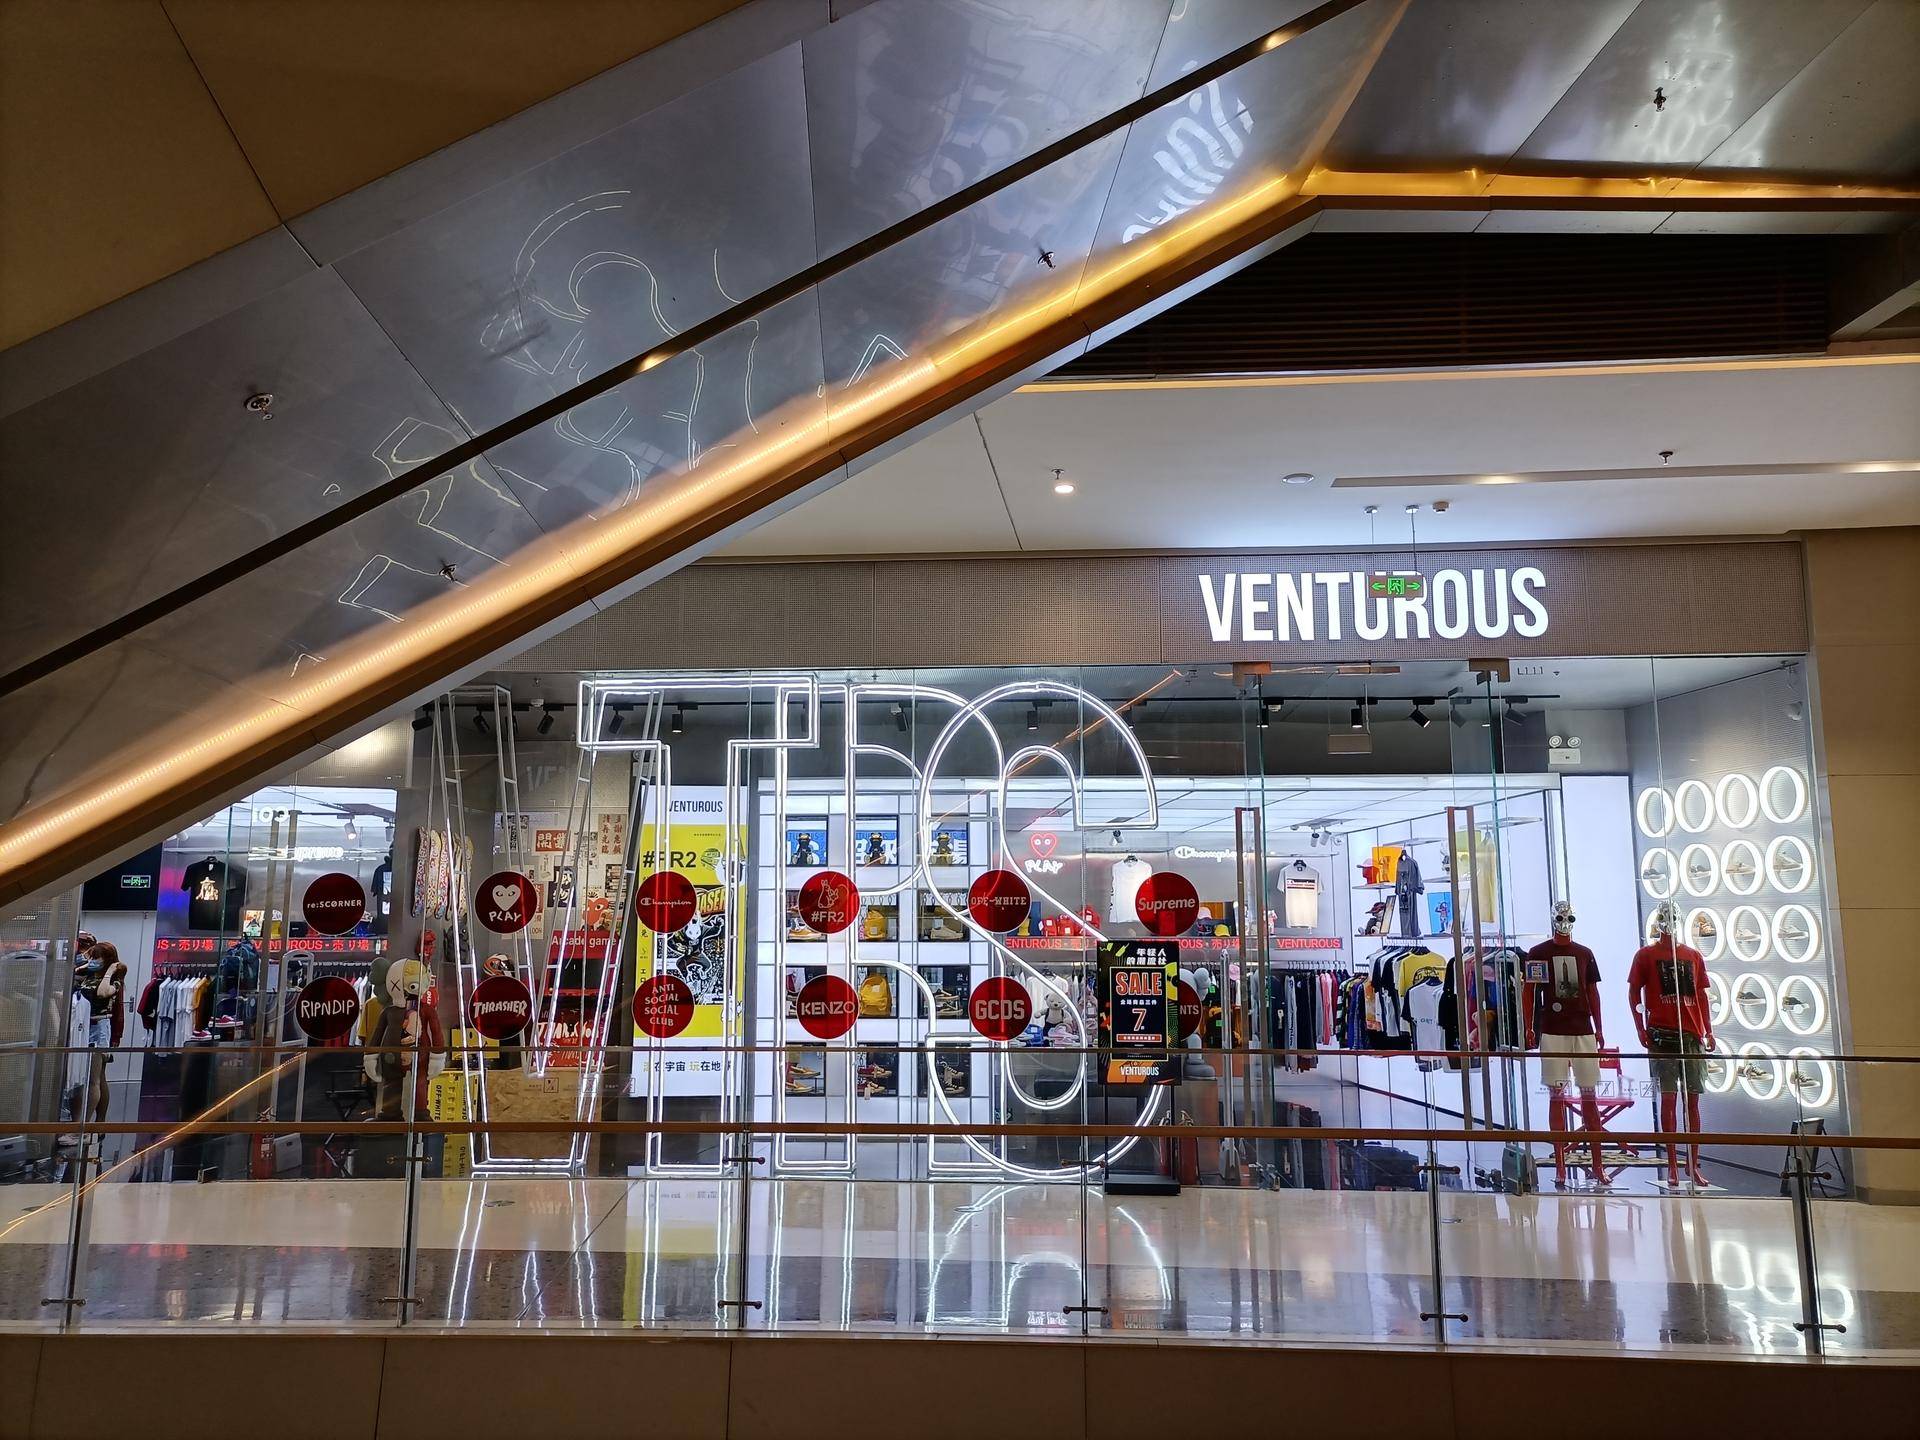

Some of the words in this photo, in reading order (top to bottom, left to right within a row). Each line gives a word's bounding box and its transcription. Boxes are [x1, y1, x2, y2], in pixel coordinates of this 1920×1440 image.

[1198, 567, 1549, 642] VENTUROUS
[1025, 860, 1063, 874] PLAY
[640, 897, 692, 907] Champion
[1138, 897, 1196, 914] Supreme
[489, 911, 522, 924] PLAY
[811, 911, 844, 923] #FR2
[1277, 938, 1341, 949] VENTUROUS
[651, 985, 675, 994] ANTI
[1115, 971, 1163, 996] SALE
[644, 994, 680, 1005] SOCIAL
[301, 1000, 355, 1019] RIPNDIP
[473, 999, 528, 1018] THRASHER
[644, 1004, 679, 1016] SOCIAL
[801, 1001, 855, 1015] KENZO
[975, 999, 1025, 1020] GCDS
[650, 1016, 674, 1027] CLUB
[1132, 1008, 1147, 1032] 7
[1120, 1066, 1160, 1076] VENTUROUS
